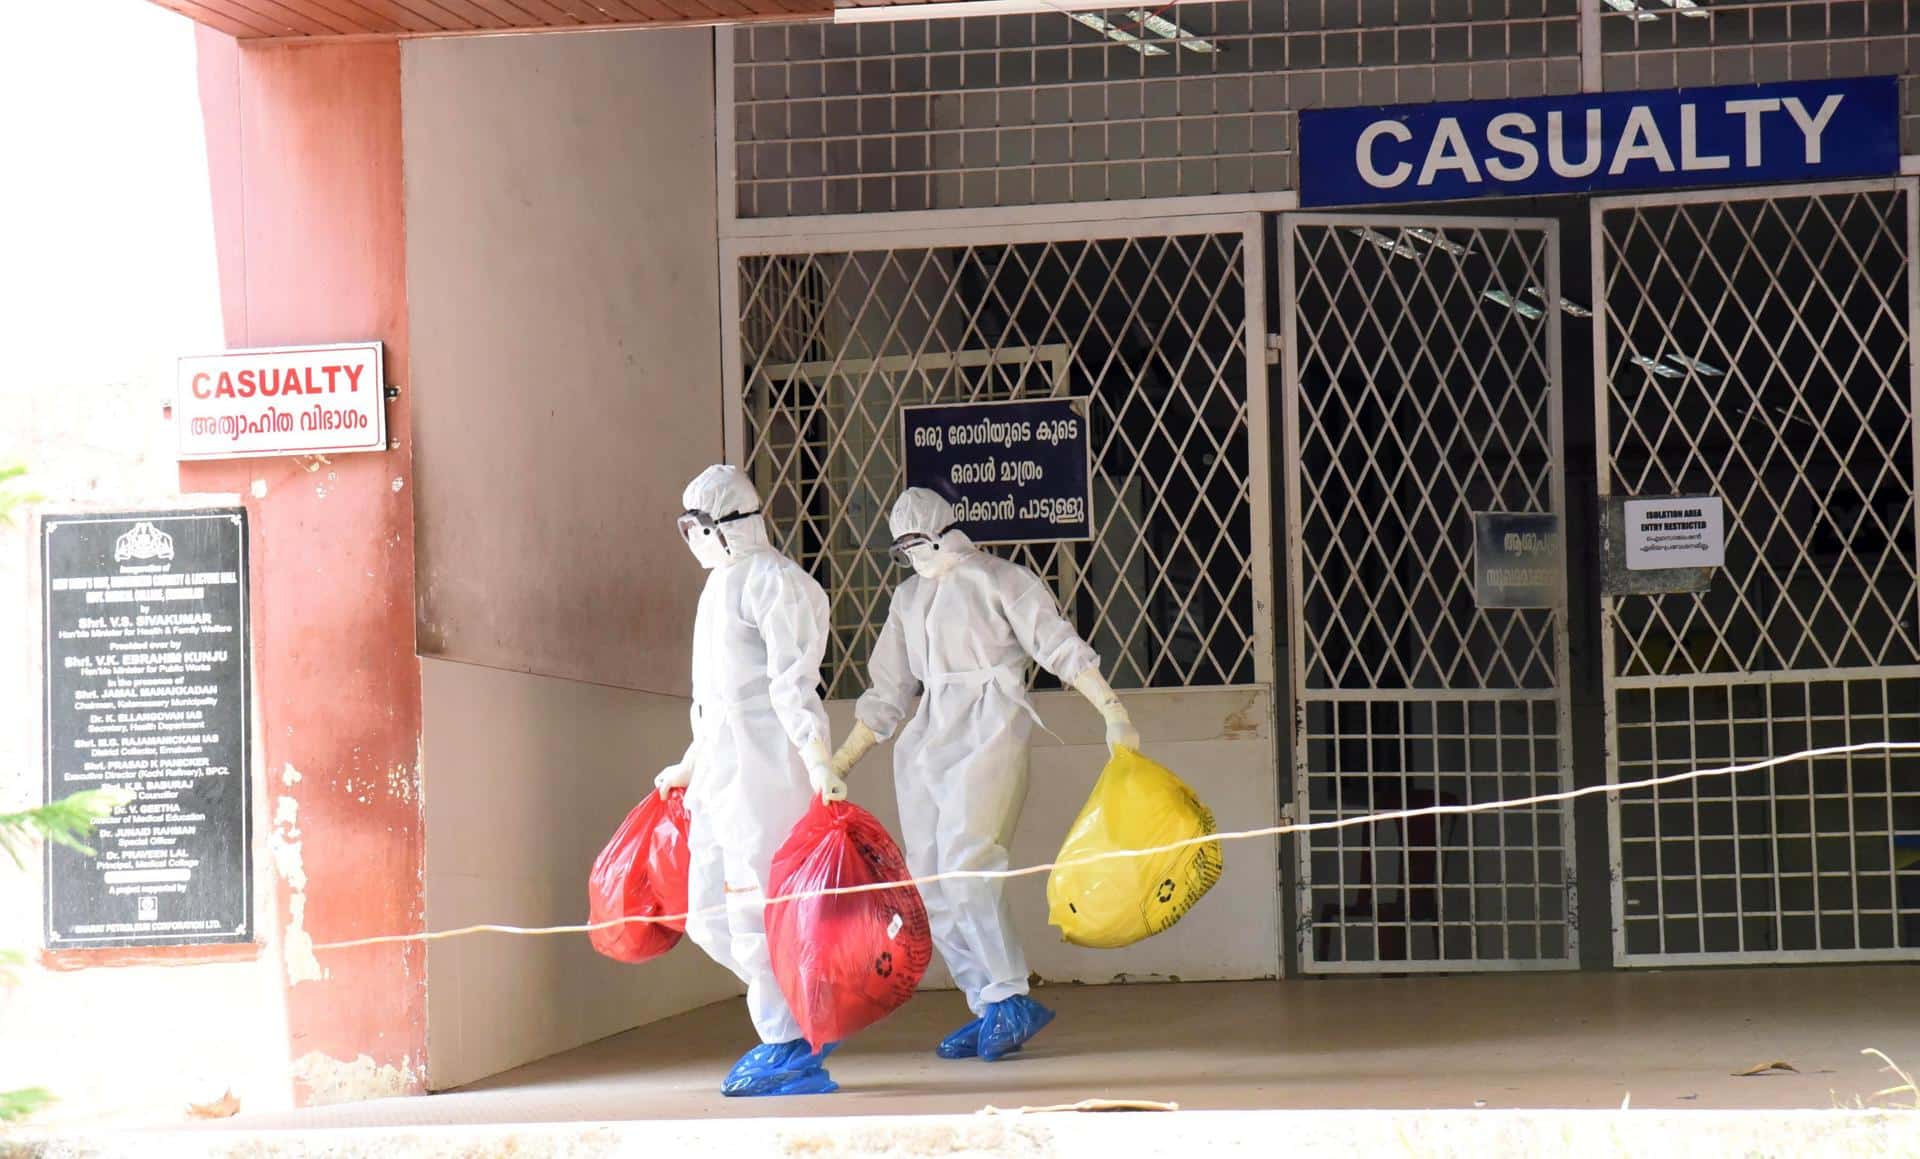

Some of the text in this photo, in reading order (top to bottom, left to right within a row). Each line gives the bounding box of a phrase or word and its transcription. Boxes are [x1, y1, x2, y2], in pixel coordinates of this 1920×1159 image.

[1355, 94, 1844, 188] CASUALTY
[191, 364, 364, 399] CASUALTY
[191, 404, 368, 441] അത്യാഹിത വിഭാഗം
[914, 425, 943, 452] ഒരു
[948, 417, 1031, 448] രോഗിയുടെ
[951, 456, 1043, 487] ഒരാൾ മാത്രം
[1646, 508, 1702, 520] ISOLATION AREA
[1640, 521, 1707, 532] ENTRY RESTRICTED
[140, 606, 149, 614] by
[79, 614, 211, 628] Shri. V.S. SIVAKUMAR
[91, 629, 124, 638] Minister
[173, 626, 199, 635] Family
[201, 625, 232, 633] Welfare
[170, 640, 181, 649] by
[65, 651, 227, 668] Shri. V.K. EBRAHIM KUNJU
[118, 678, 131, 686] the
[134, 678, 173, 686] presence
[102, 689, 138, 698] JAMAL
[90, 715, 103, 723] Dr.
[106, 714, 115, 722] K.
[186, 711, 202, 719] IAS
[158, 721, 204, 730] Department
[108, 761, 148, 769] PRASAD
[105, 771, 136, 779] Director
[129, 805, 138, 813] V.
[141, 804, 180, 813] GEETHA
[166, 813, 205, 821] Education
[170, 849, 188, 857] LAL
